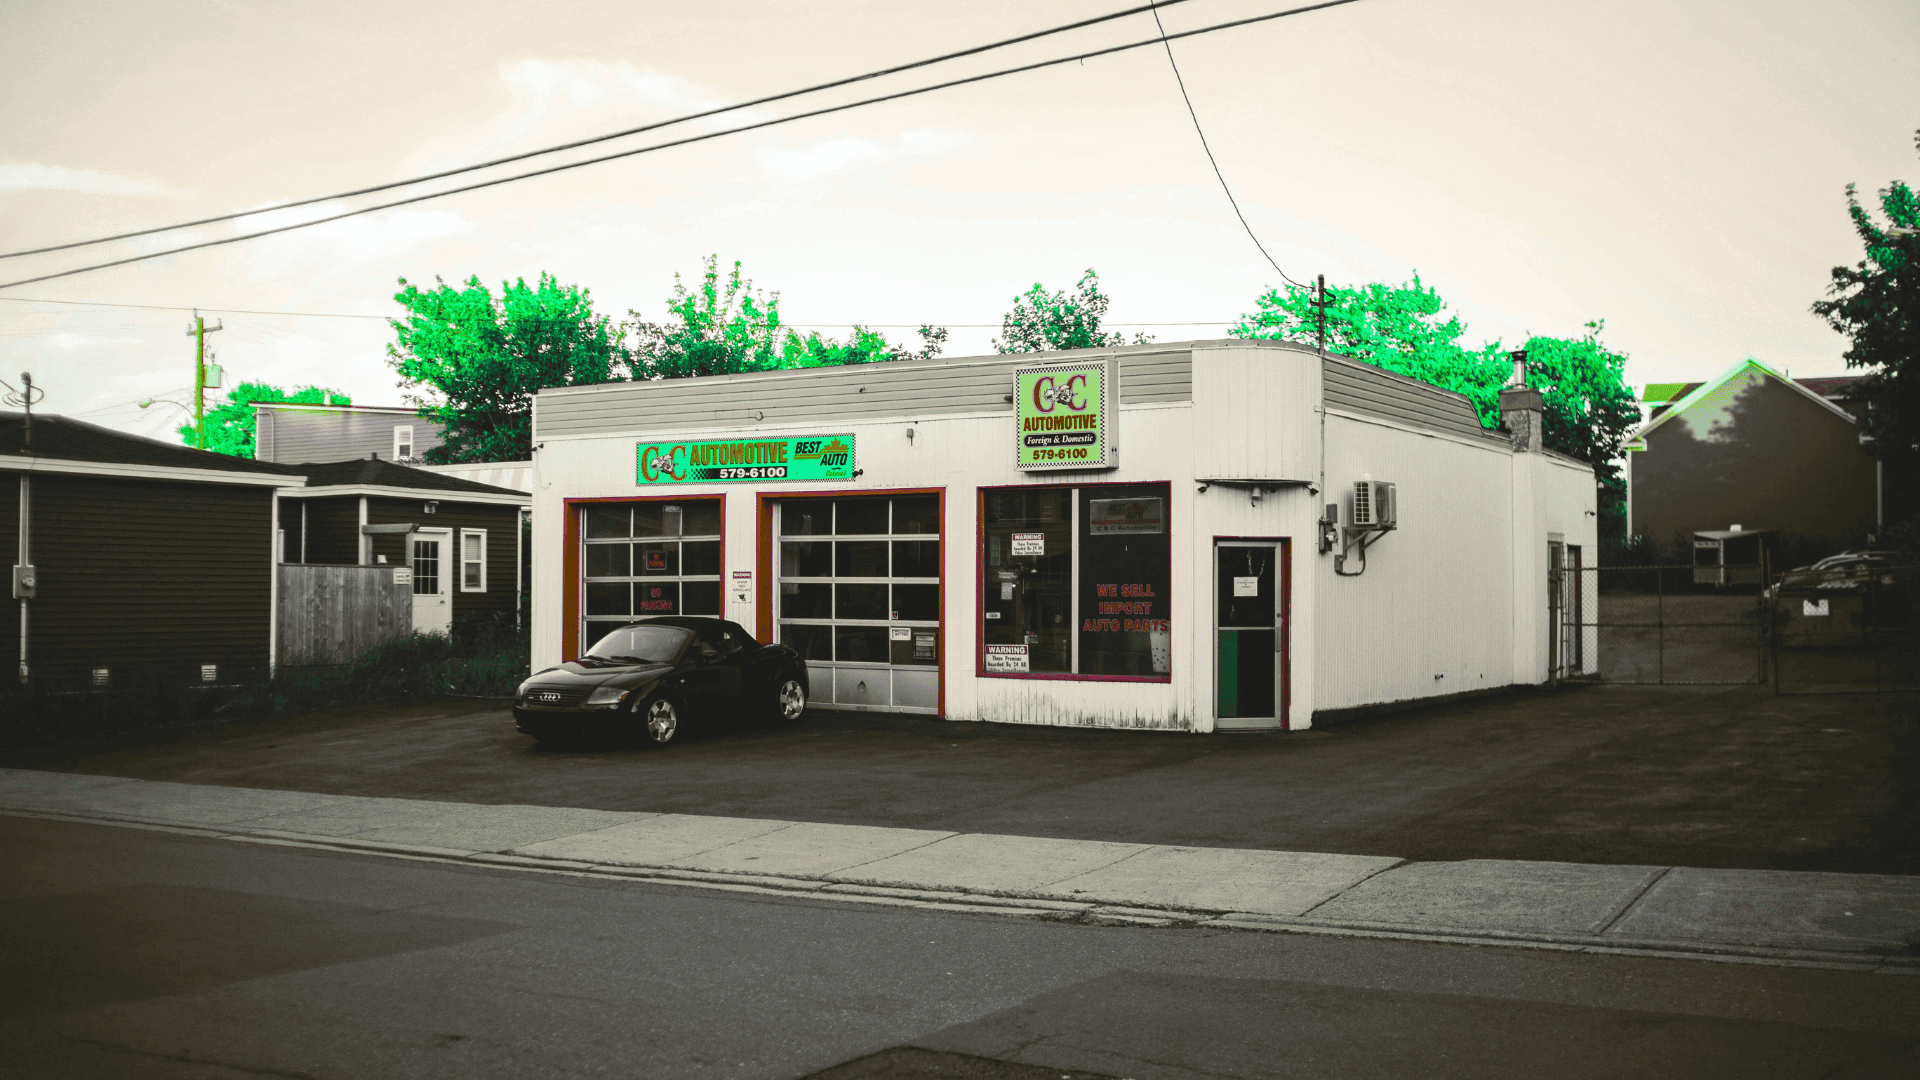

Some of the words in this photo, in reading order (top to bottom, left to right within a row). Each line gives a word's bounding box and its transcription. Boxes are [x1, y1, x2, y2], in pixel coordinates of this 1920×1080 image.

[1023, 414, 1097, 431] AUTOMOTIVE
[1027, 437, 1052, 446] Foreign
[1053, 435, 1060, 443] &
[1062, 434, 1094, 443] Domestic
[690, 441, 788, 466] AUTOMOTIVE
[795, 441, 822, 454] BEST
[820, 453, 848, 466] AUTO
[1032, 448, 1088, 460] 579-6100
[719, 467, 786, 479] 579-6100
[1108, 503, 1126, 512] BEST
[1096, 584, 1118, 596] WE
[1121, 584, 1155, 597] SELL
[640, 600, 672, 610] PARKING
[1099, 602, 1152, 614] IMPORT
[1083, 619, 1121, 632] AUTO
[1124, 619, 1168, 632] PARTS
[988, 646, 1026, 654] WARNING
